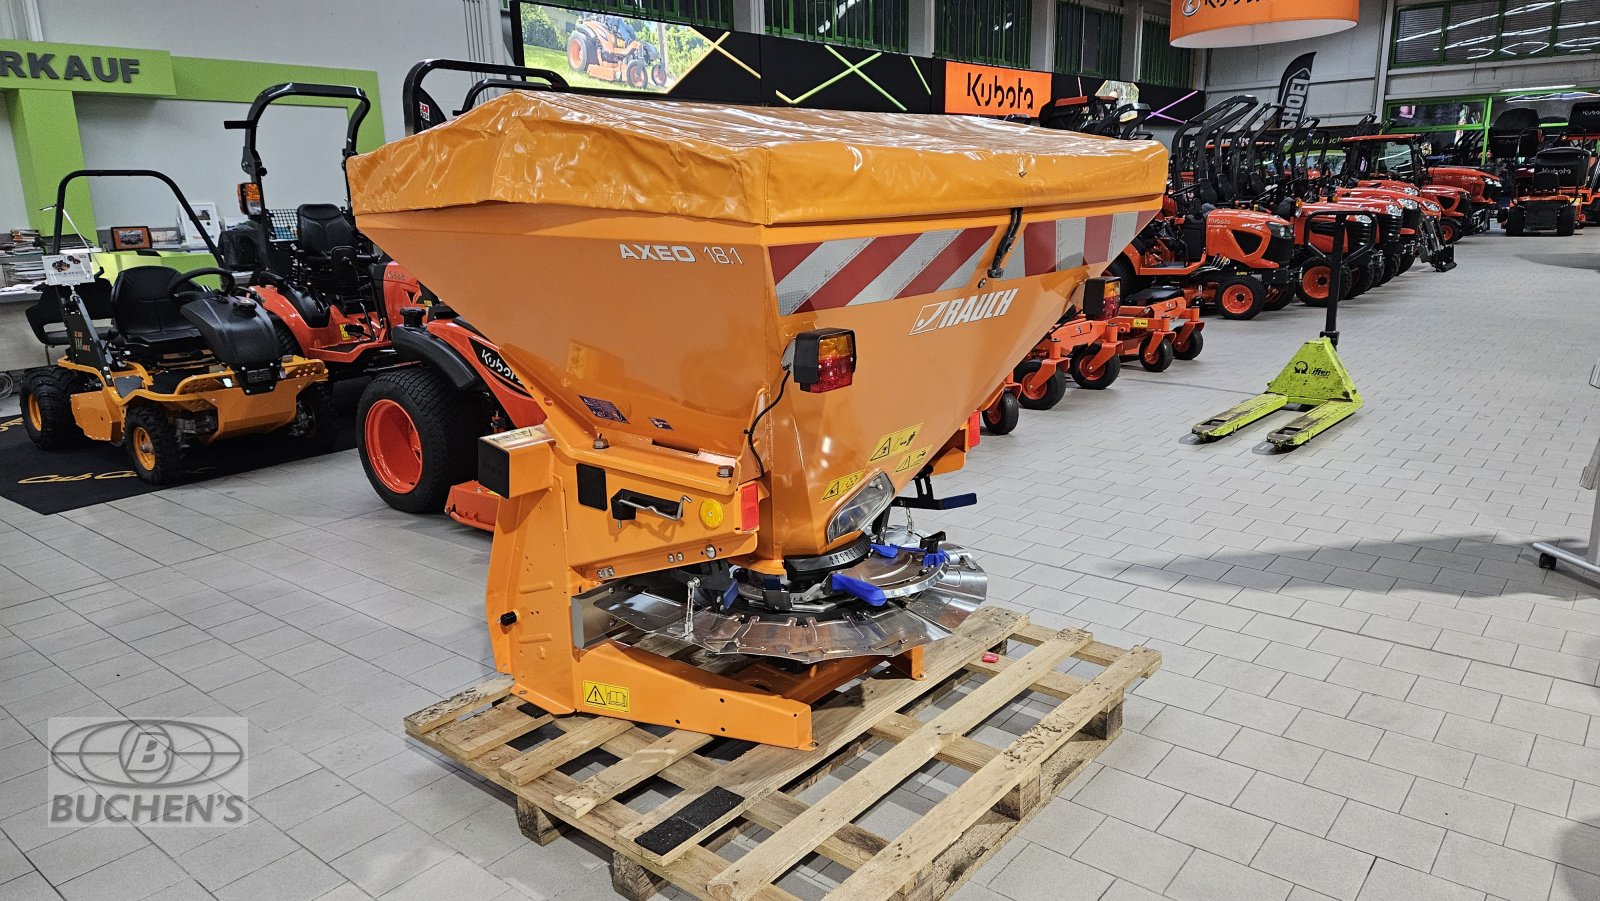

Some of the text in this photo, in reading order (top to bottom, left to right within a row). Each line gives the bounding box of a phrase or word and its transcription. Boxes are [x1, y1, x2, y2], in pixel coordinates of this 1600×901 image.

[967, 72, 1034, 110] Kubota
[619, 243, 744, 265] AXEO 18.1
[938, 288, 1019, 329] RAUCH
[481, 349, 523, 385] Kubo
